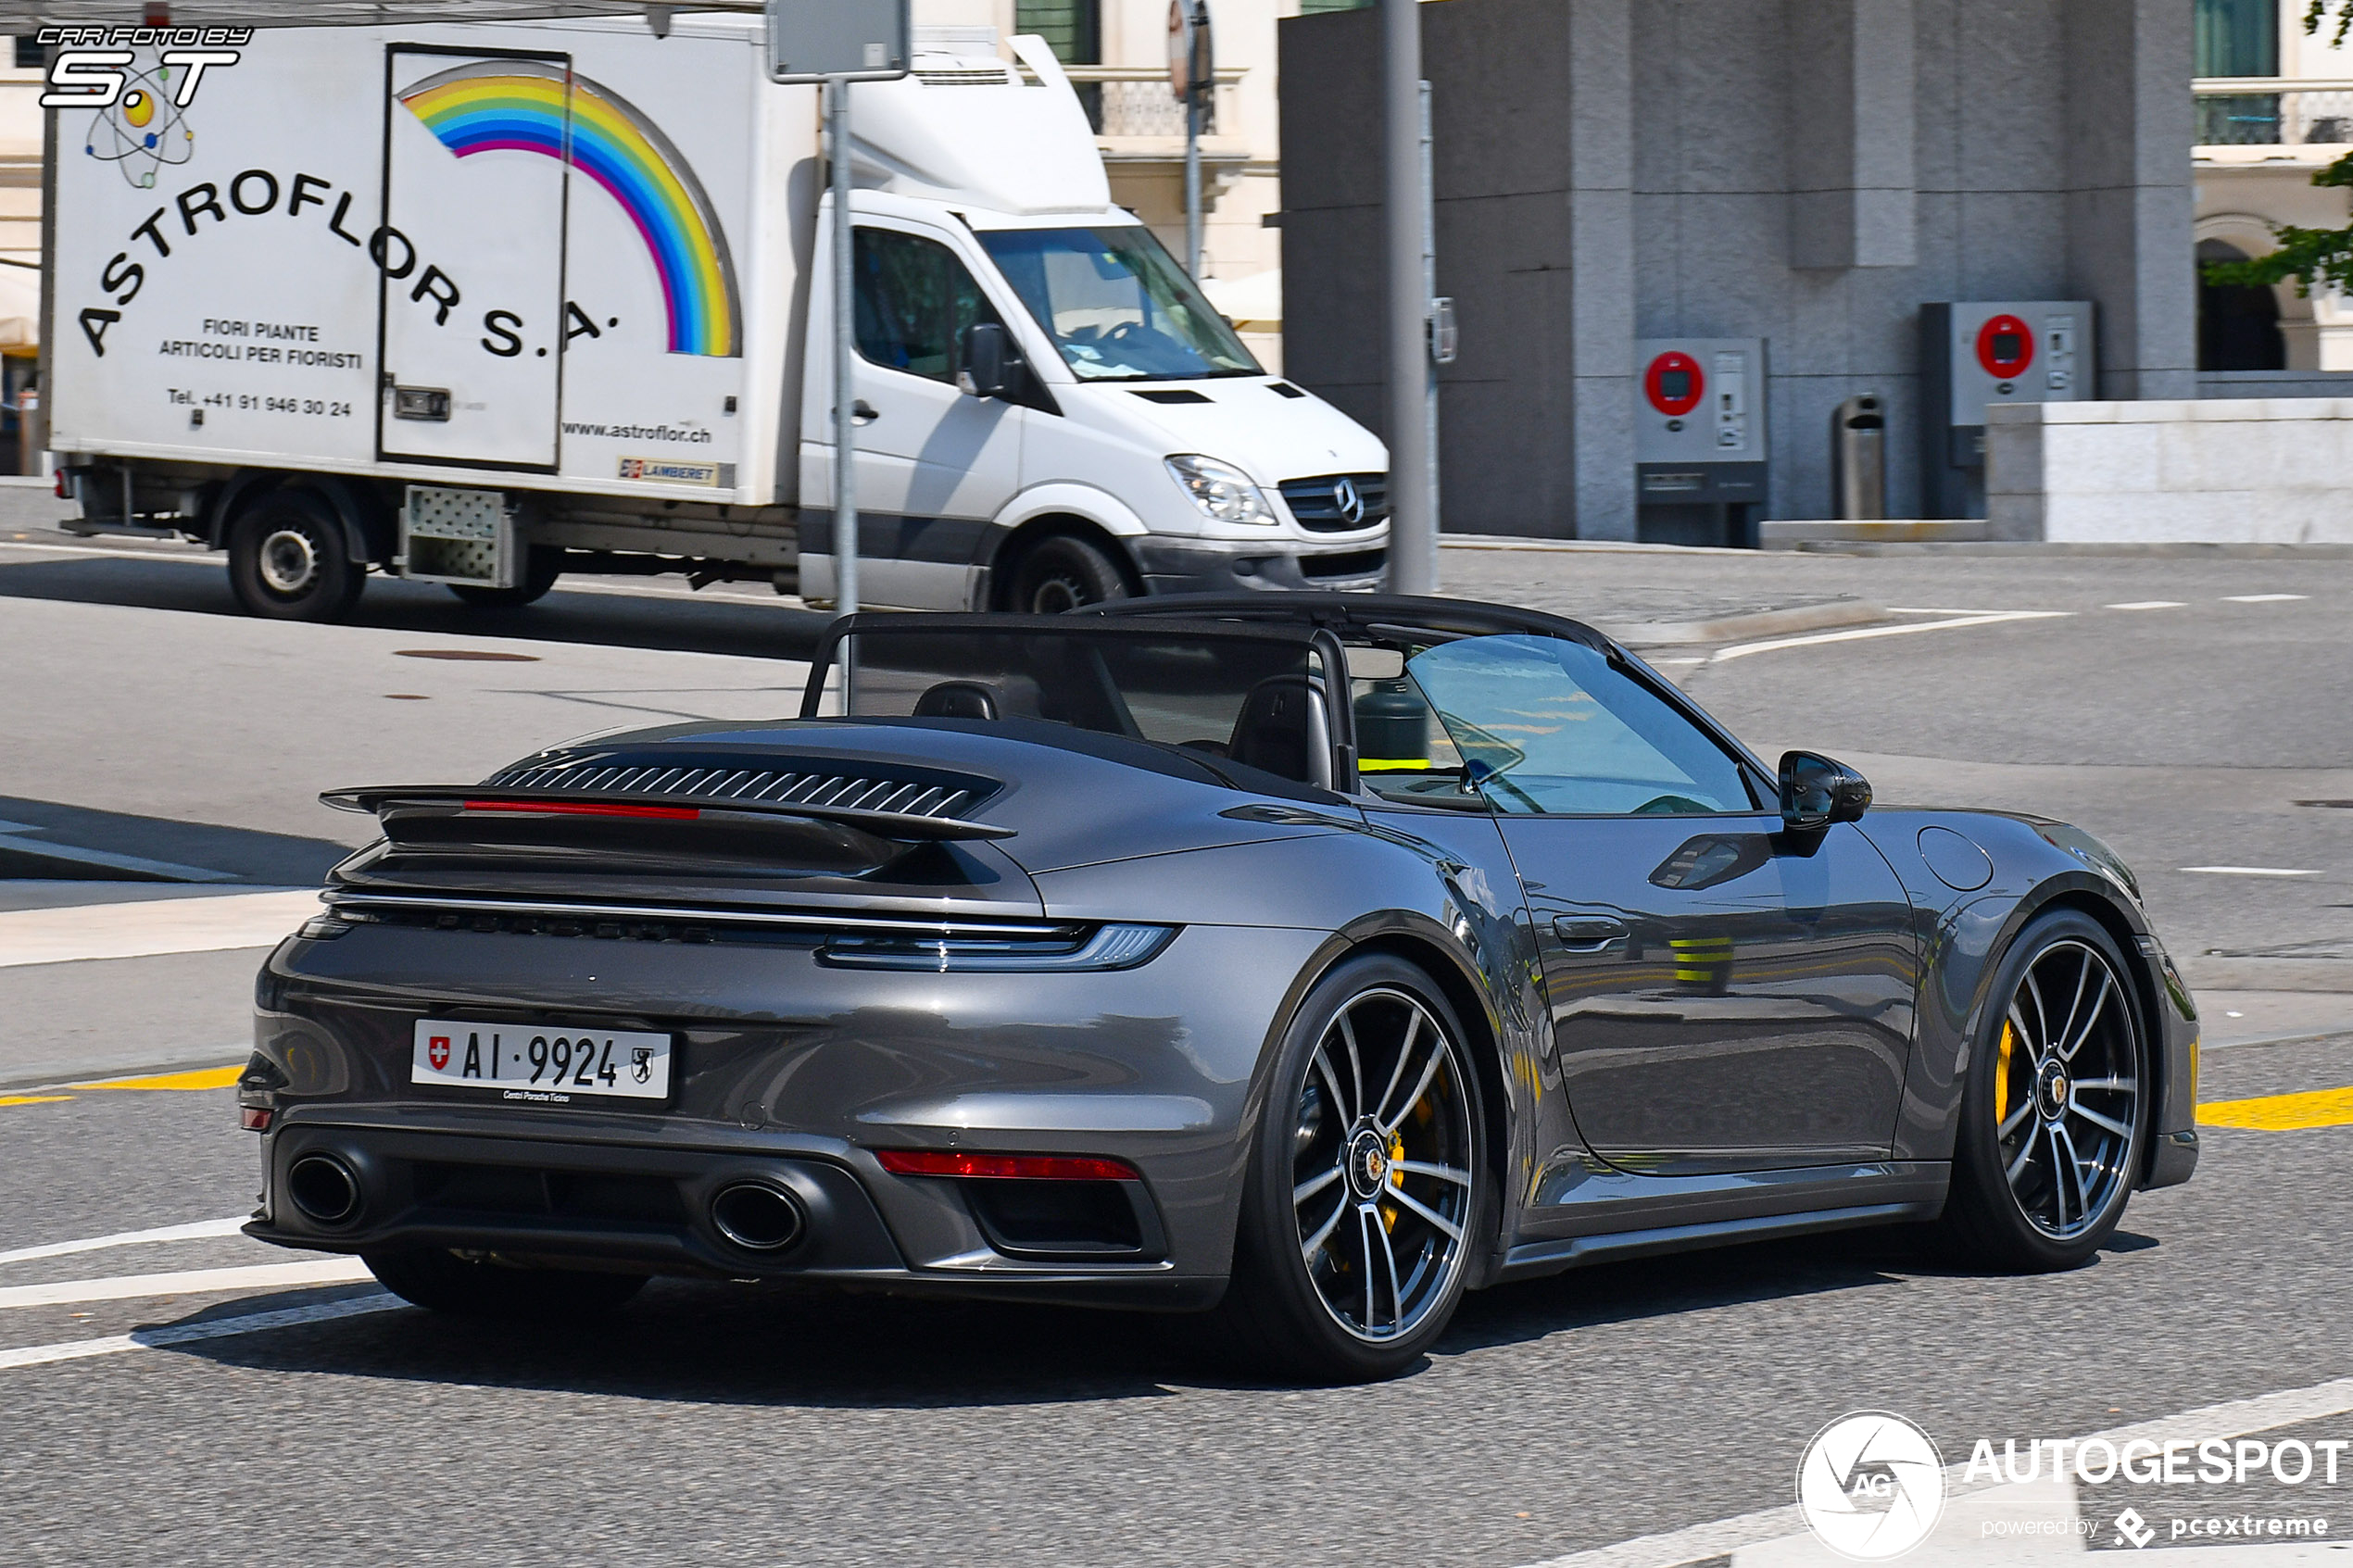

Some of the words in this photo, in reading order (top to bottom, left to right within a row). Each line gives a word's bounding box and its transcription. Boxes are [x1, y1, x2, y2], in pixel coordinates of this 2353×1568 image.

[79, 169, 460, 358] ASTROFLOR
[203, 319, 249, 337] FIORI
[255, 323, 320, 343] PIANTE
[159, 340, 241, 360] ARTICOLI
[246, 346, 282, 363] PER
[286, 349, 362, 370] FIORISTI
[167, 388, 196, 405] Tel.
[203, 393, 233, 408] +41
[238, 395, 258, 410] 91
[265, 396, 297, 413] 946
[303, 399, 324, 415] 30
[330, 401, 352, 417] 24
[561, 421, 712, 444] www.astroflor.ch
[643, 465, 713, 480] LAMBERET
[523, 1091, 549, 1102] Porsche
[549, 1093, 570, 1103] Ticino
